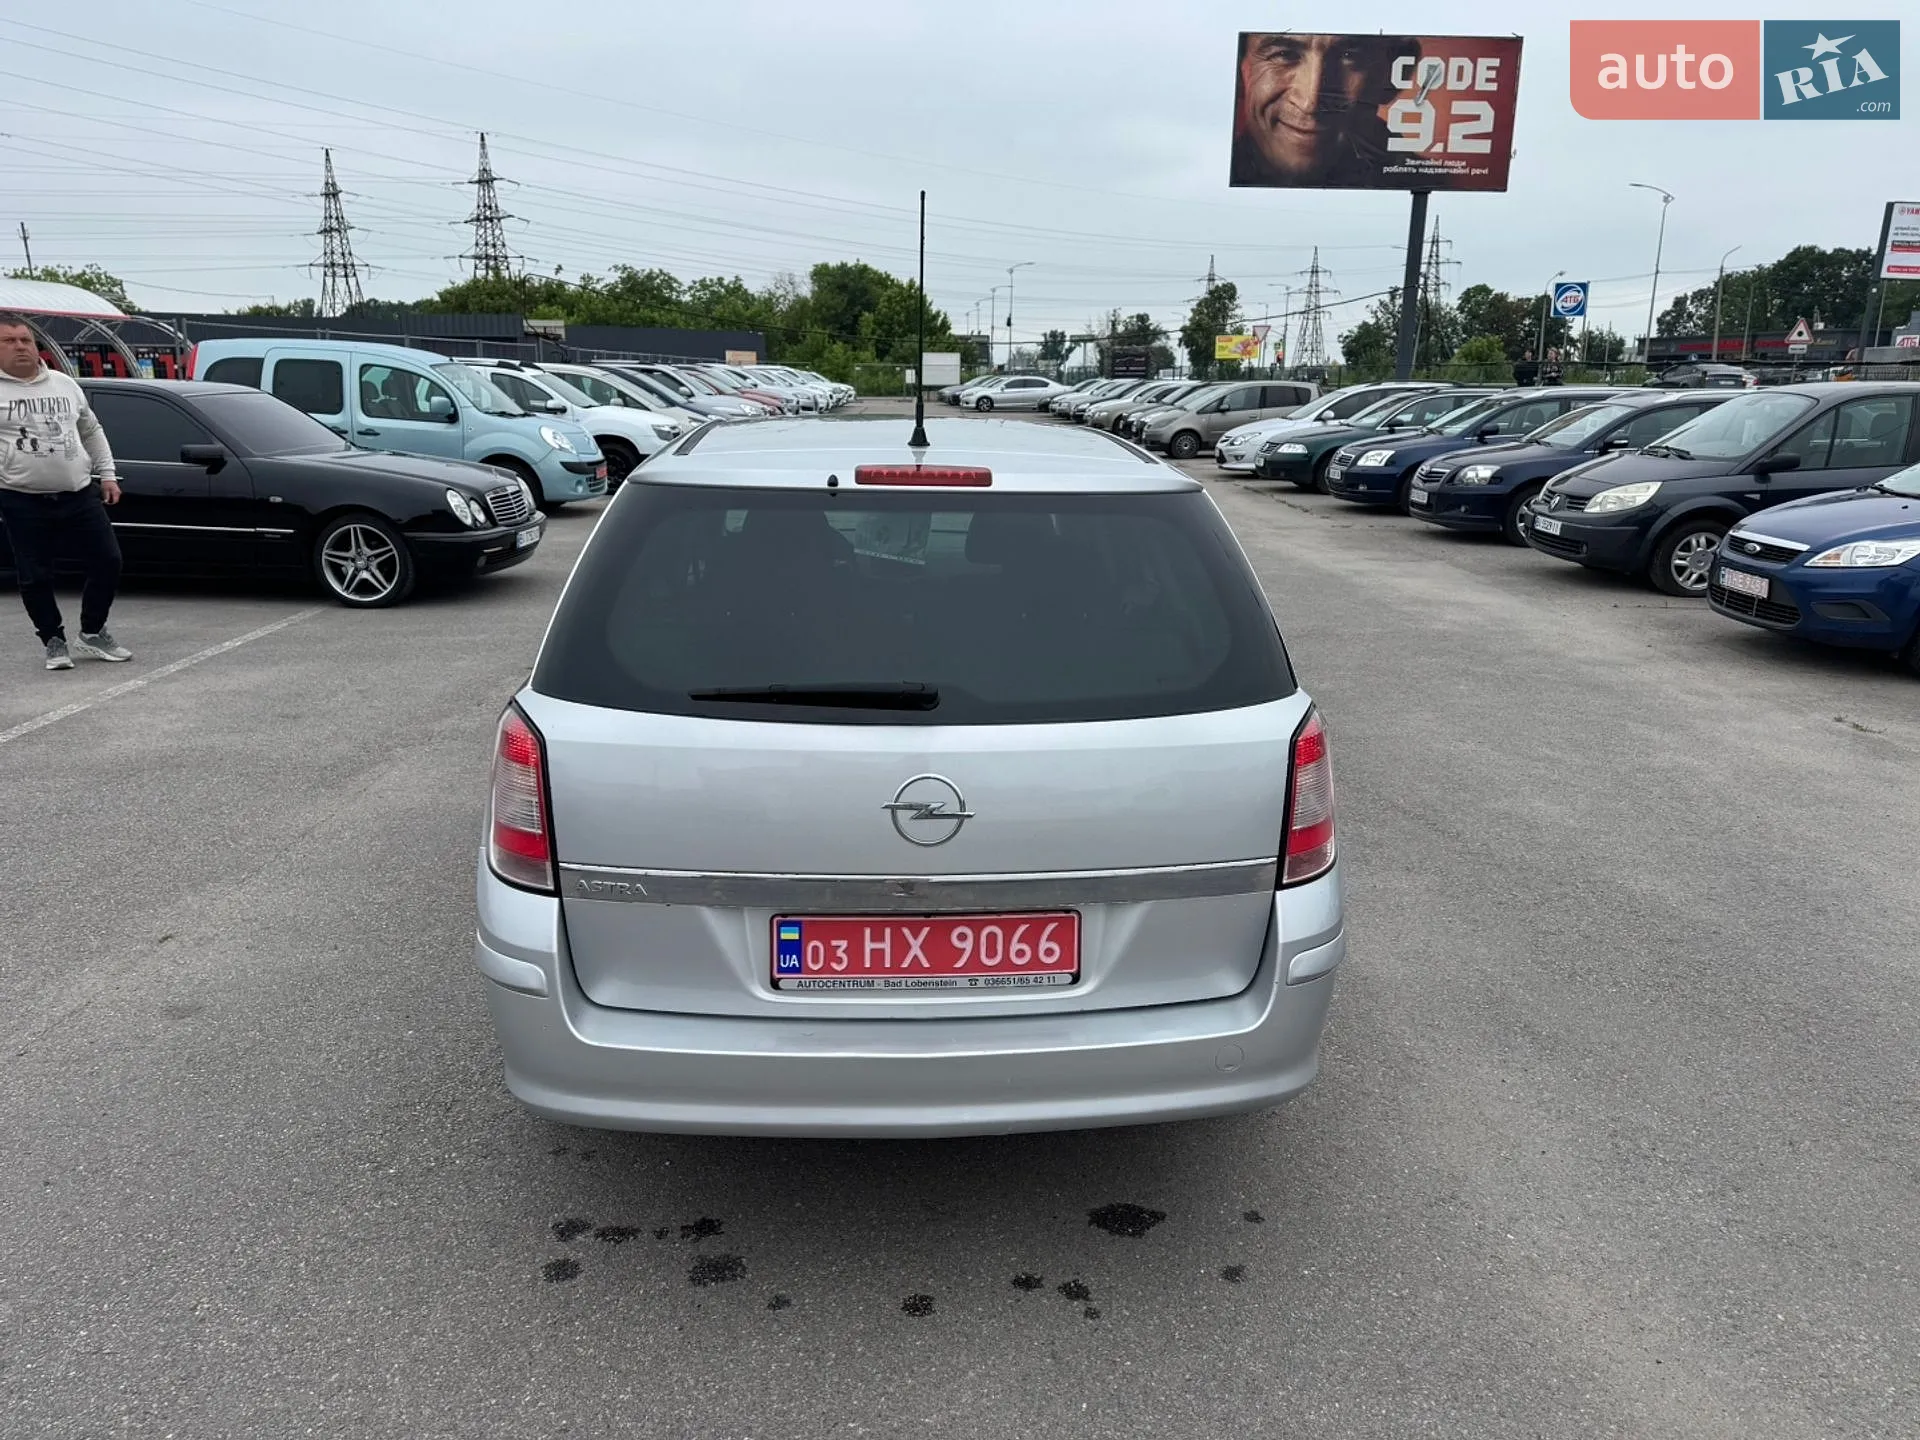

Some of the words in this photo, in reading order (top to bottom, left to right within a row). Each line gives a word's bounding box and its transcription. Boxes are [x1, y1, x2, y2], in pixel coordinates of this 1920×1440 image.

[1390, 56, 1500, 91] CODE
[7, 396, 71, 421] POWERED
[575, 879, 648, 896] ASTRA
[780, 954, 799, 968] UA
[806, 940, 848, 971] 03
[863, 926, 931, 969] HX
[950, 922, 1061, 968] 9066
[797, 980, 875, 988] AUTOCENTRUM
[884, 979, 901, 988] Bad
[905, 979, 957, 987] Lobenstein
[1033, 976, 1044, 984] 42
